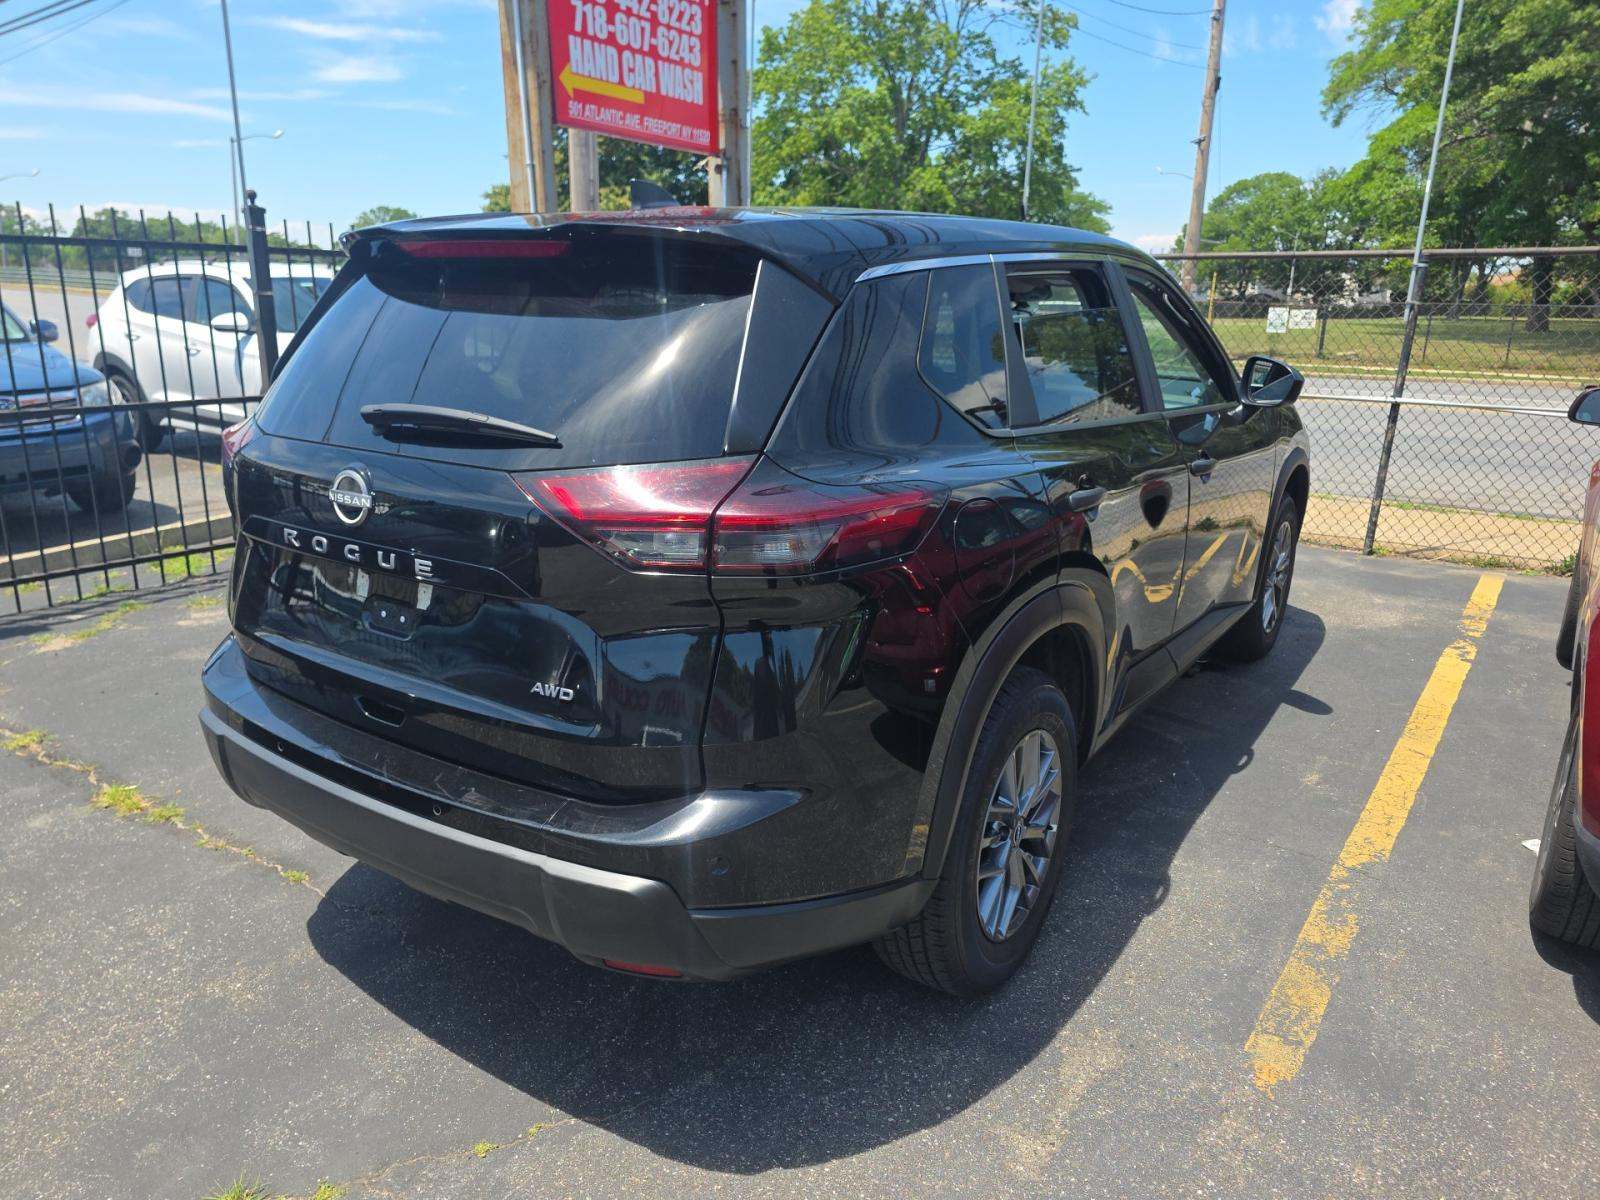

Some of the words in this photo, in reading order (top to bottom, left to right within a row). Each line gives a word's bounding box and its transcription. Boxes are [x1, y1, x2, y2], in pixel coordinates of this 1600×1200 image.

[571, 0, 701, 68] 718-607-6243
[568, 34, 619, 83] HAND
[622, 50, 656, 93] CAR
[658, 60, 703, 105] WASH
[584, 103, 624, 127] ATLANTIC
[329, 489, 371, 508] NISSAN
[283, 527, 433, 577] ROGUE
[530, 682, 574, 701] AWD
